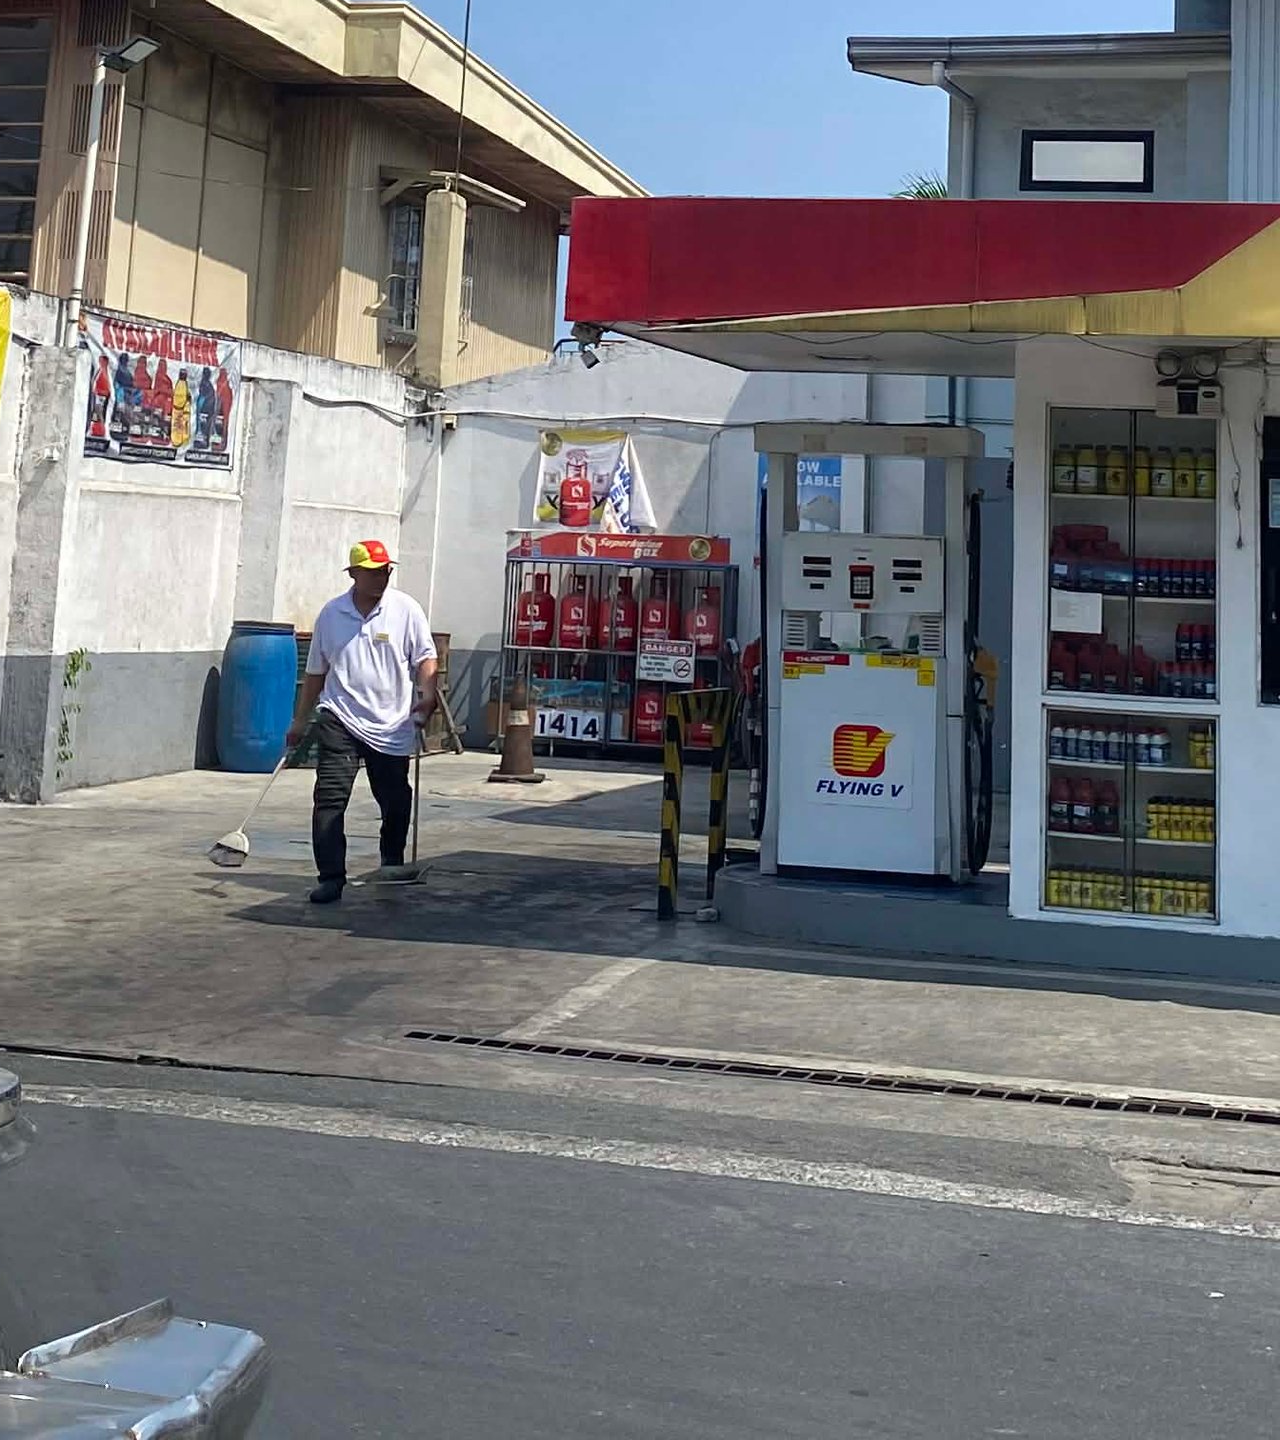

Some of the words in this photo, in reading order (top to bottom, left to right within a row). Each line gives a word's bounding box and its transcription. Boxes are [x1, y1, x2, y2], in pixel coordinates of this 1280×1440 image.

[797, 461, 820, 473] OW
[645, 644, 687, 654] DANGER
[816, 780, 884, 797] FLYING
[890, 784, 904, 798] V
